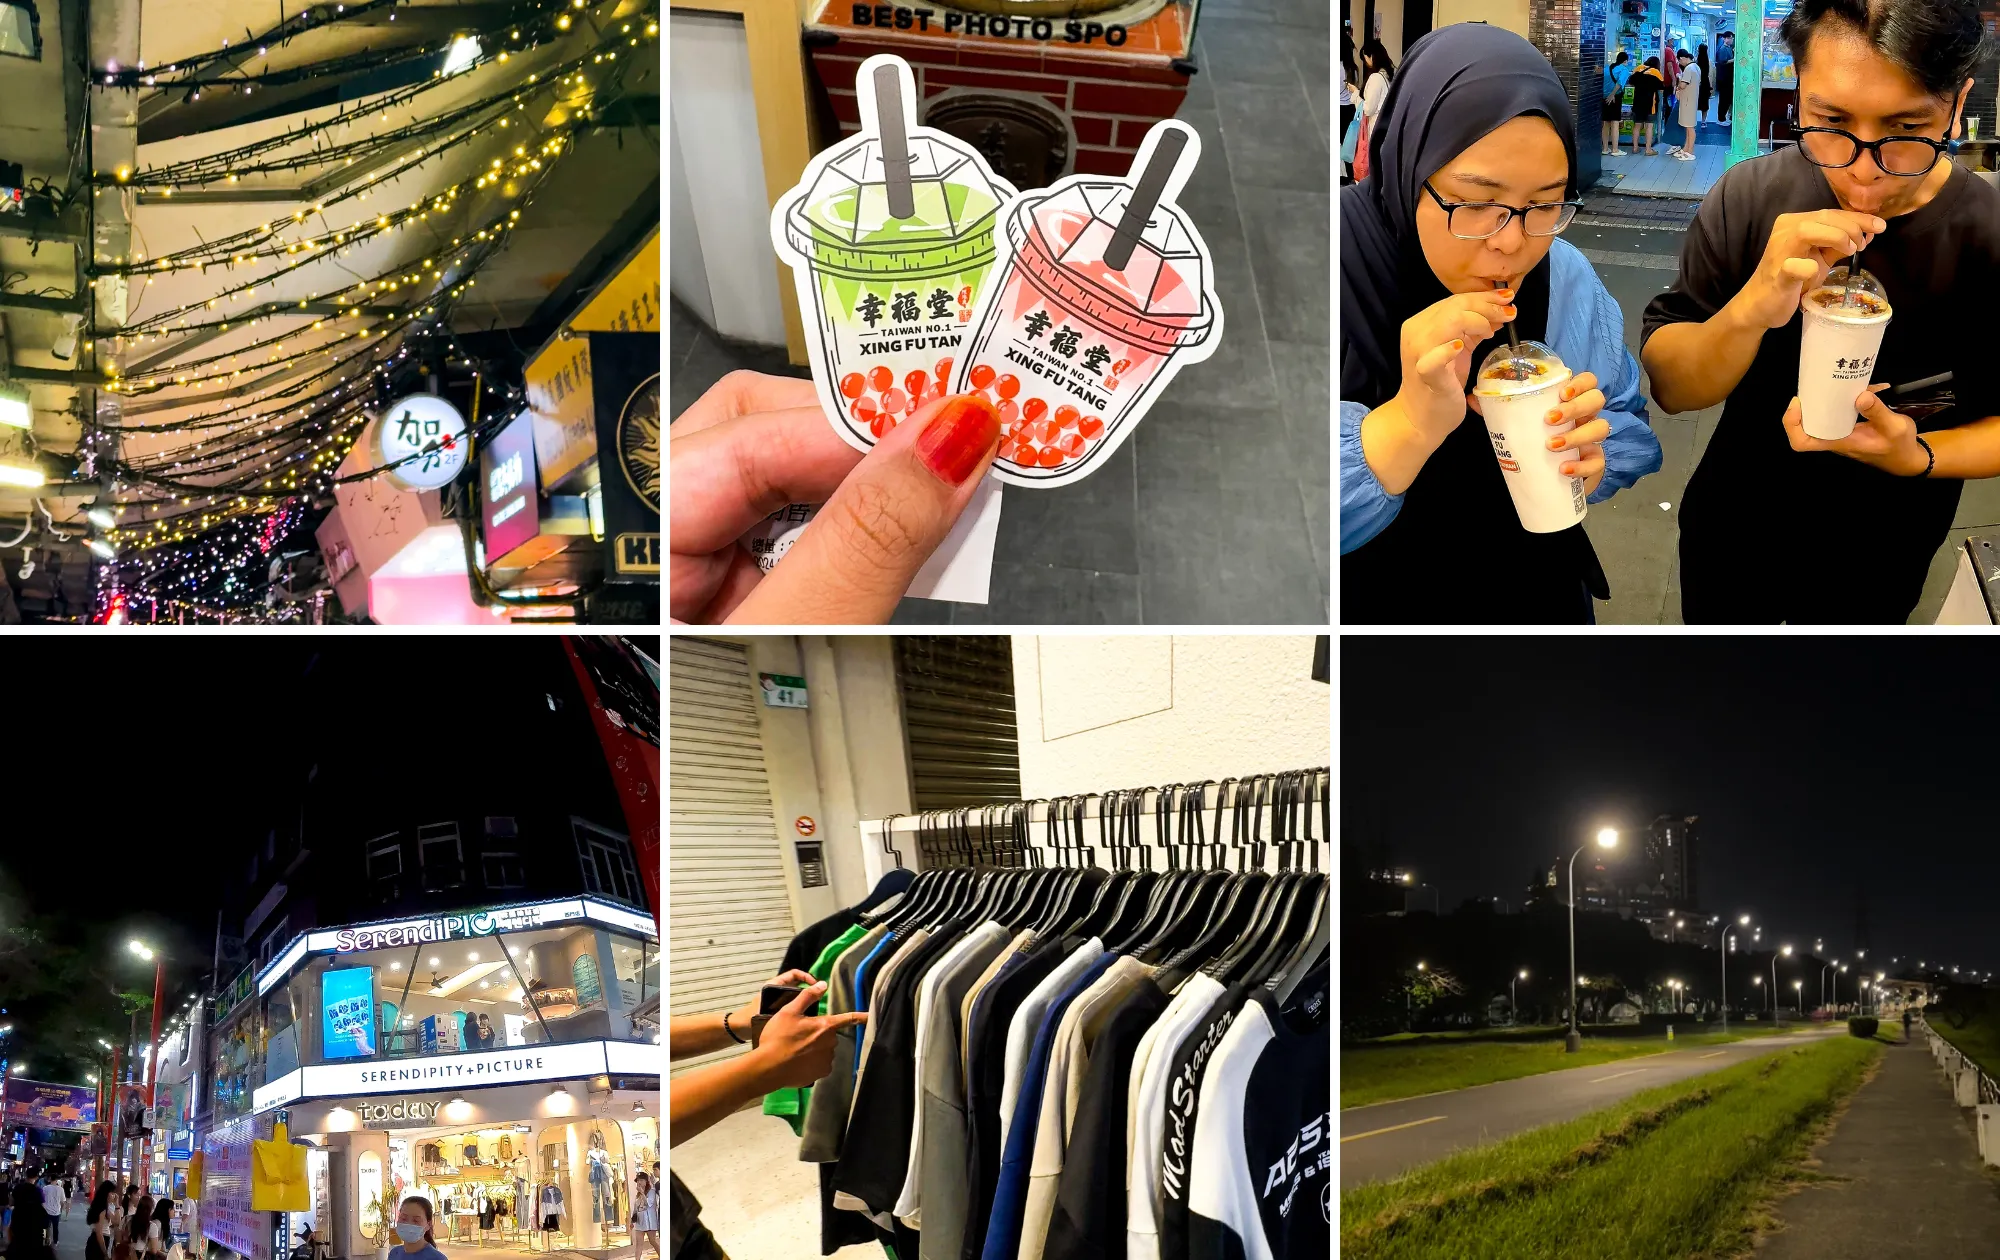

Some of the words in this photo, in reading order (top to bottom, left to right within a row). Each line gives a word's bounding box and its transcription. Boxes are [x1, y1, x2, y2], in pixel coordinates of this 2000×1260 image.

[852, 4, 934, 31] BEST
[944, 13, 1052, 40] PHOTO
[1063, 22, 1127, 46] SPO
[856, 288, 954, 328] 幸福堂
[860, 341, 902, 356] XING
[905, 337, 926, 351] FU
[881, 326, 922, 337] TAIWAN
[926, 324, 951, 333] NO.1
[1024, 310, 1111, 376] 幸福堂
[1004, 346, 1045, 375] XING
[1043, 368, 1066, 386] FU
[1066, 379, 1107, 411] TANG
[1032, 346, 1069, 371] TAIWAN
[1070, 368, 1094, 387] NO.1
[445, 454, 459, 464] 2F
[778, 690, 793, 704] 41
[361, 1057, 544, 1083] SERENDIPITY+PICTURE
